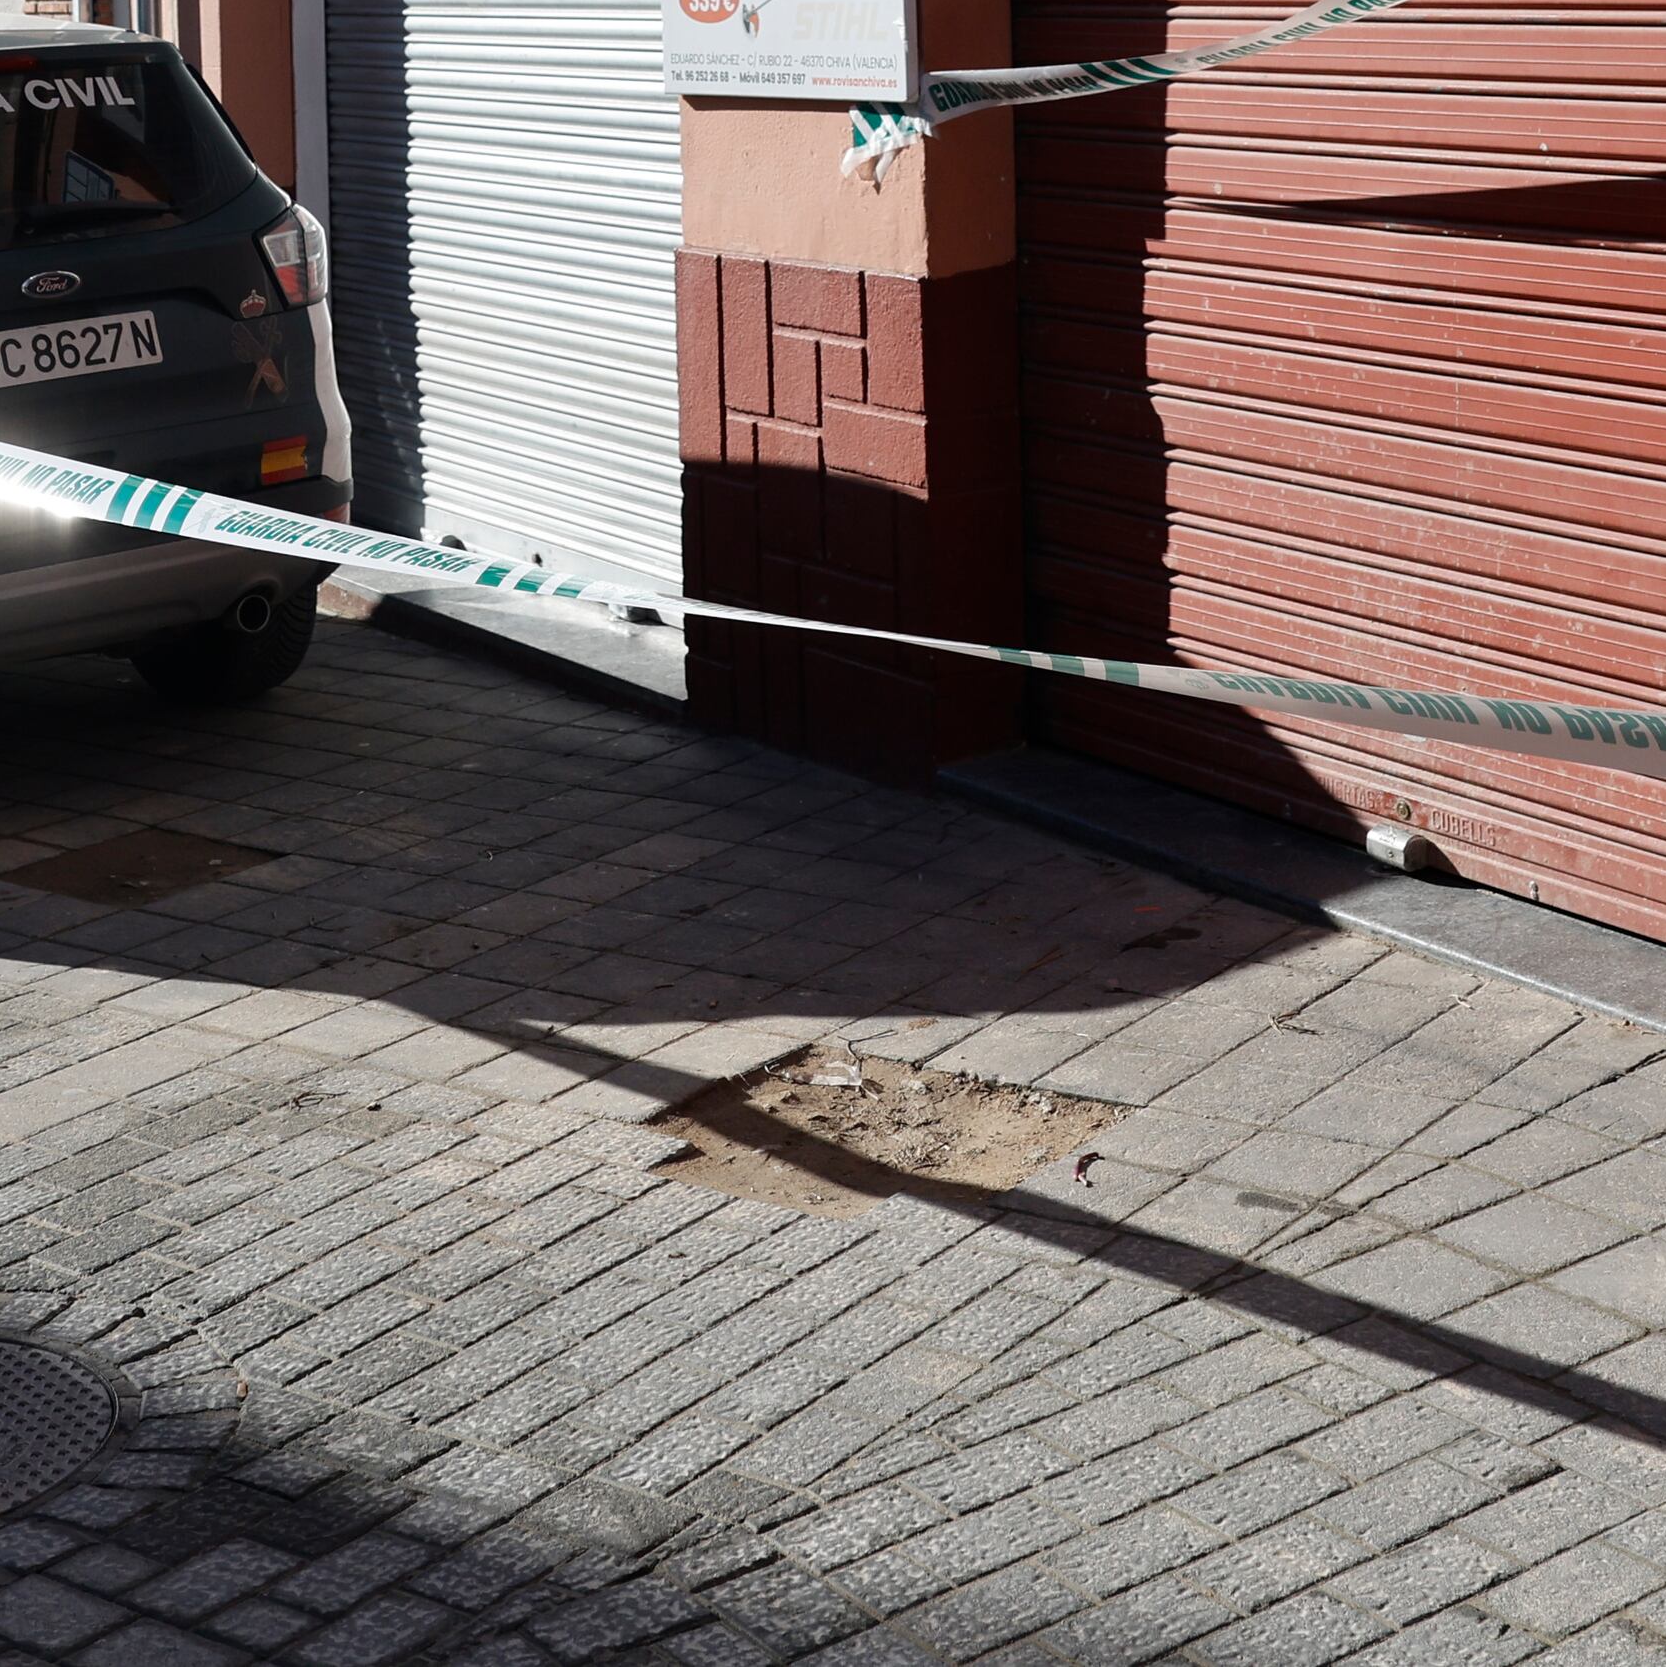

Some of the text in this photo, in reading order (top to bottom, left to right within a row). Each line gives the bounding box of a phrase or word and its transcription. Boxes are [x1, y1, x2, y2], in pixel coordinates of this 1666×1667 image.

[792, 1, 888, 43] STIHL
[670, 53, 705, 65] EDUARDO
[758, 54, 782, 67] RUBIO
[783, 55, 793, 67] 22
[826, 55, 851, 68] CHIVA
[24, 75, 136, 111] CIVIL
[35, 277, 70, 294] Ford
[41, 469, 116, 505] PASAR
[214, 509, 485, 573] GUARDIA CIVIL NO PASAR
